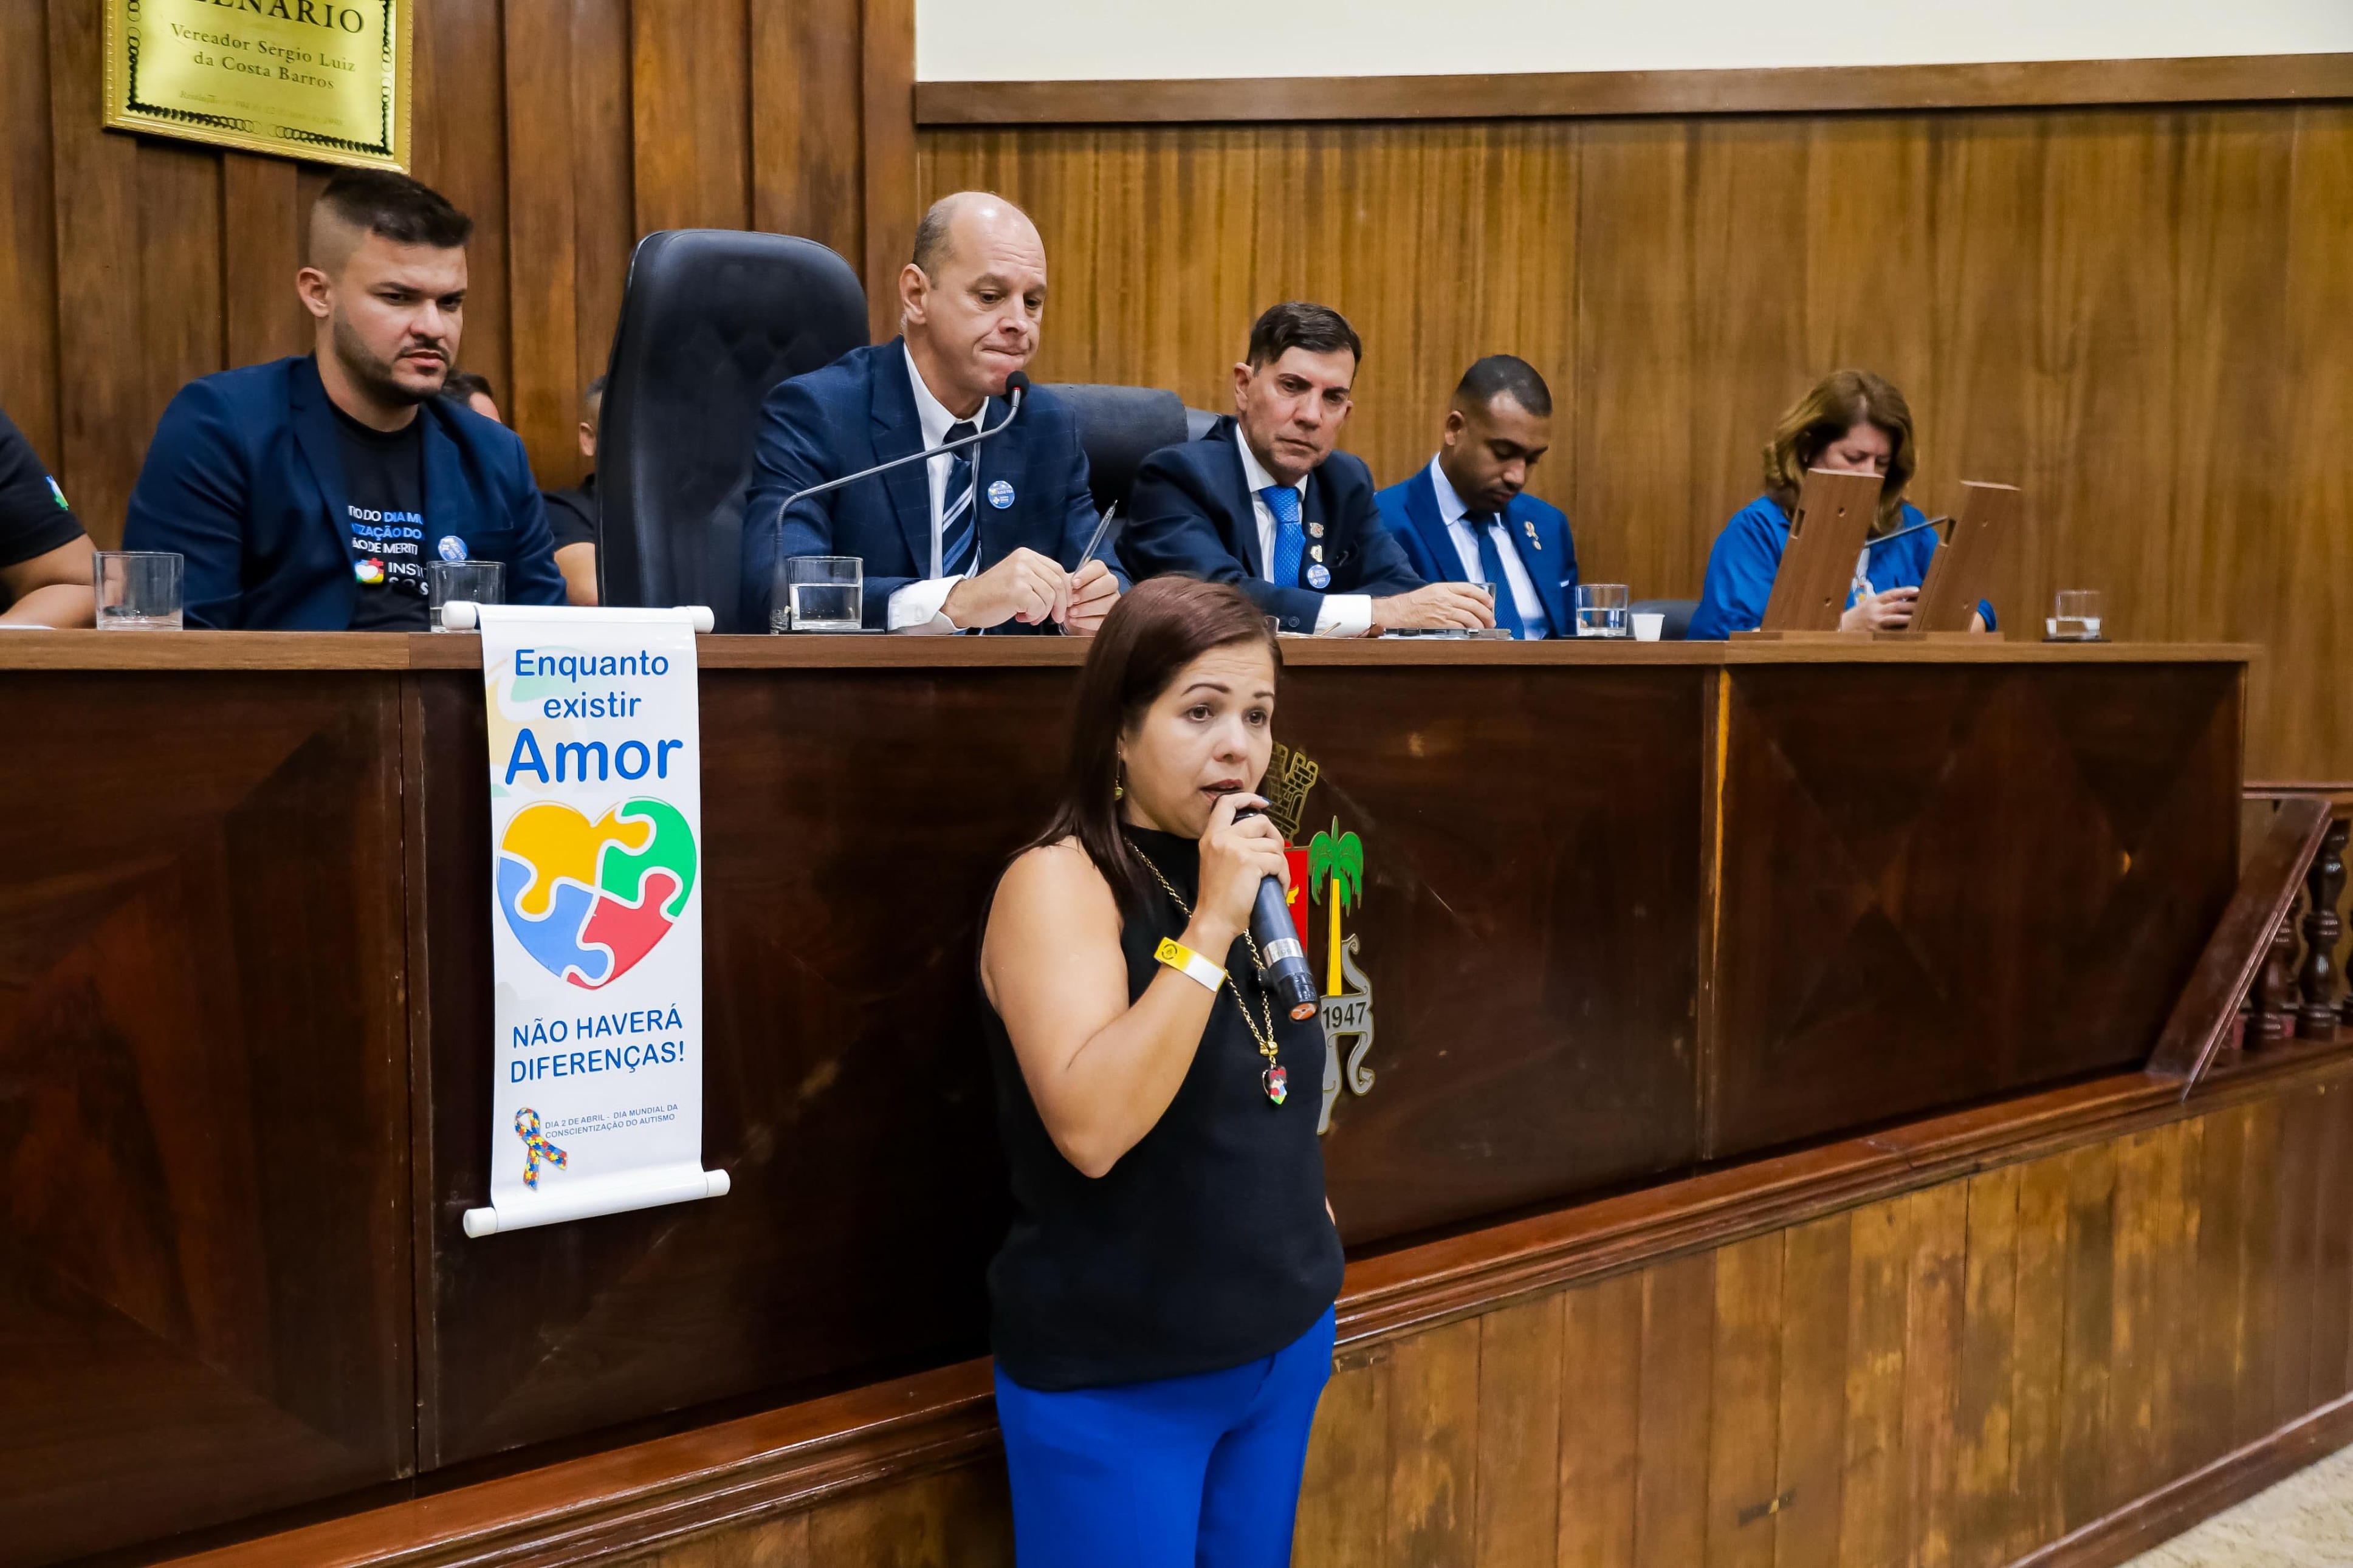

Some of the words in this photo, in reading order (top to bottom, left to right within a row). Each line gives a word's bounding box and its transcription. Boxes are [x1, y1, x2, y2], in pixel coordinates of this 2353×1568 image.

[171, 23, 250, 50] Vereador
[258, 40, 312, 63] Sergio
[320, 53, 356, 72] Luiz
[194, 52, 215, 67] da
[222, 56, 271, 77] Costa
[279, 66, 334, 90] Barros
[363, 509, 382, 521] DO
[383, 512, 406, 522] DIA
[368, 541, 382, 553] DE
[403, 527, 422, 539] DO
[515, 649, 669, 683] Enquanto
[544, 691, 641, 719] existir
[505, 728, 683, 785] Amor
[513, 1017, 568, 1049] NÃO
[577, 1003, 683, 1039] HAVERÁ
[1322, 1001, 1367, 1029] 1947
[510, 1040, 684, 1083] DIFERENÇAS!
[545, 1120, 624, 1138] CONSCIENTIZAÇÃO
[626, 1118, 637, 1127] DO
[639, 1113, 675, 1125] AUTISMO
[580, 1114, 605, 1124] ABRIL
[614, 1110, 627, 1119] DIA
[629, 1106, 665, 1117] MUNDIAL
